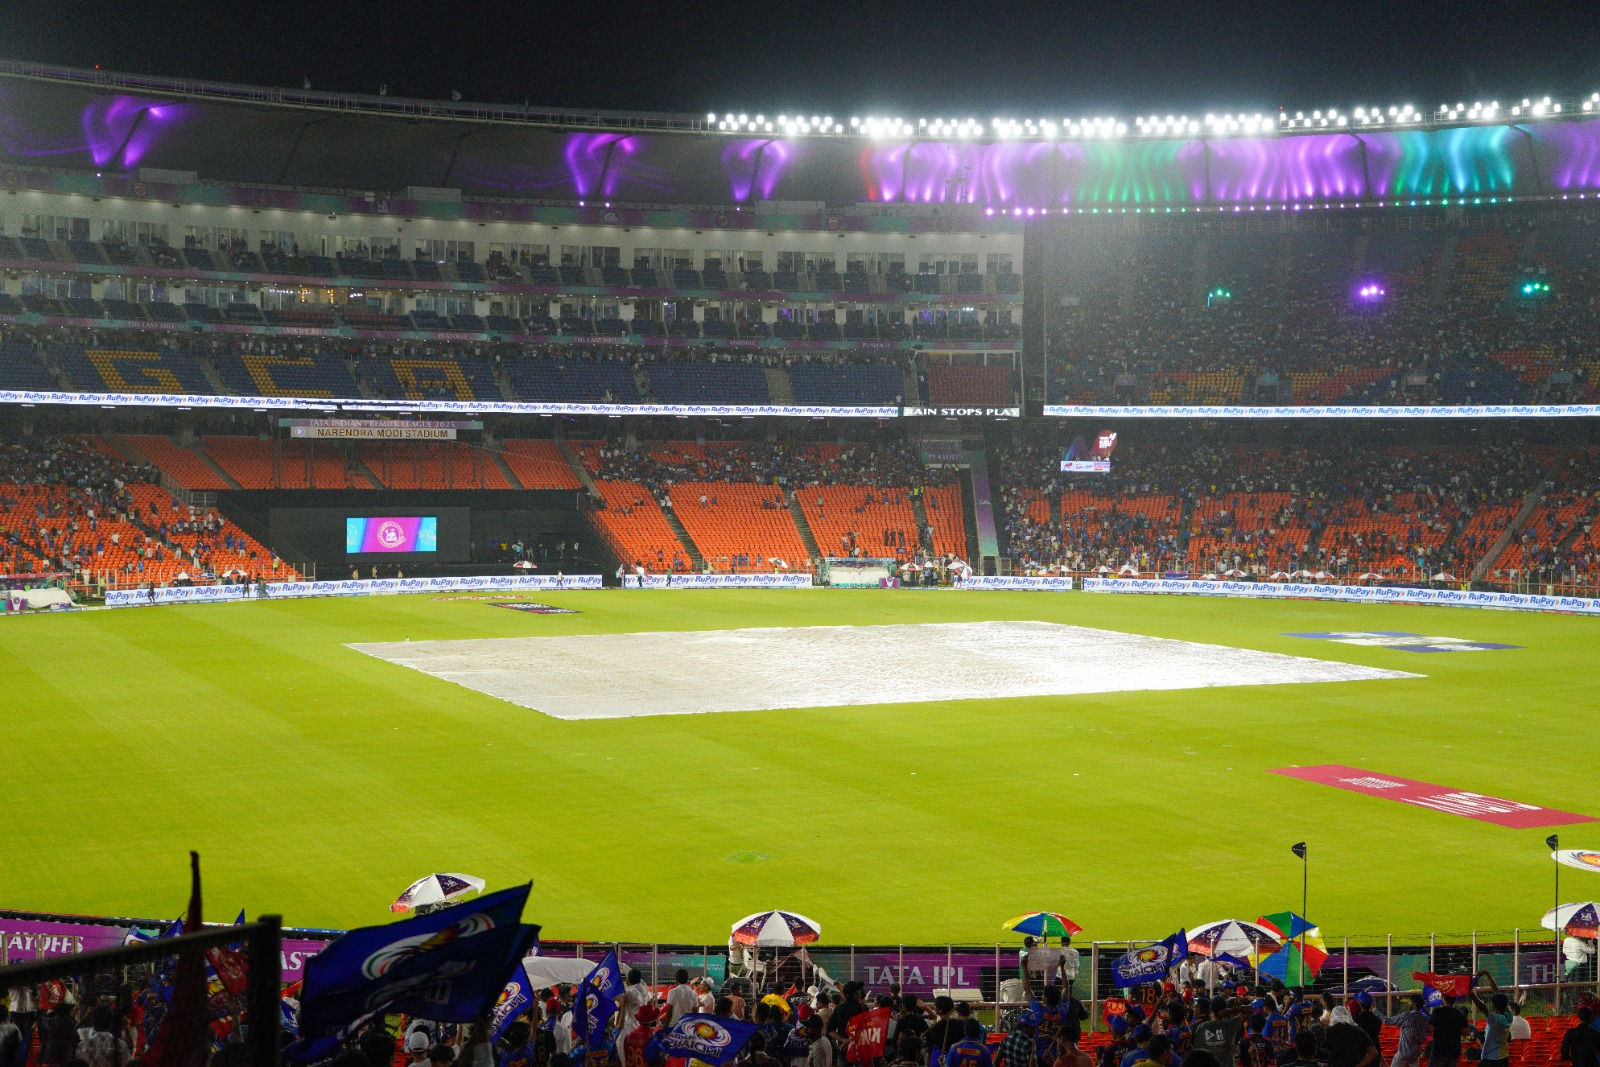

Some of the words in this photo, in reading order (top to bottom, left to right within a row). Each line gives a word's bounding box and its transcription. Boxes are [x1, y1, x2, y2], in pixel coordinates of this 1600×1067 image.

[241, 355, 332, 397] C
[941, 408, 983, 416] STOPS
[317, 429, 373, 437] NARENDRA
[376, 429, 402, 437] MODI
[405, 429, 448, 438] STADIUM
[695, 575, 720, 583] RuPay
[105, 591, 130, 600] RuPay
[166, 588, 190, 597] RuPay
[195, 587, 219, 595] RuPay
[282, 583, 307, 592] RuPay
[312, 582, 337, 590] RuPay
[341, 581, 366, 589] RuPay
[371, 580, 394, 588] RuPay
[460, 578, 483, 586] RuPay
[1131, 580, 1156, 588] RuPay
[1162, 581, 1186, 589] RuPay
[1192, 582, 1216, 590] RuPay
[1222, 583, 1247, 591] RuPay
[1252, 584, 1277, 592] RuPay
[1283, 585, 1308, 593] RuPay
[1314, 586, 1340, 594] RuPay
[1345, 588, 1370, 596] RuPay
[1375, 589, 1402, 597] RuPay
[1407, 591, 1433, 599] RuPay
[1437, 592, 1463, 600] RuPay
[1469, 594, 1495, 602] RuPay
[1499, 596, 1525, 604] RuPay
[1530, 597, 1555, 606] RuPay
[1560, 599, 1586, 608] RuPay
[863, 965, 925, 985] TATA
[933, 966, 970, 986] IPL
[1140, 987, 1156, 1004] 18
